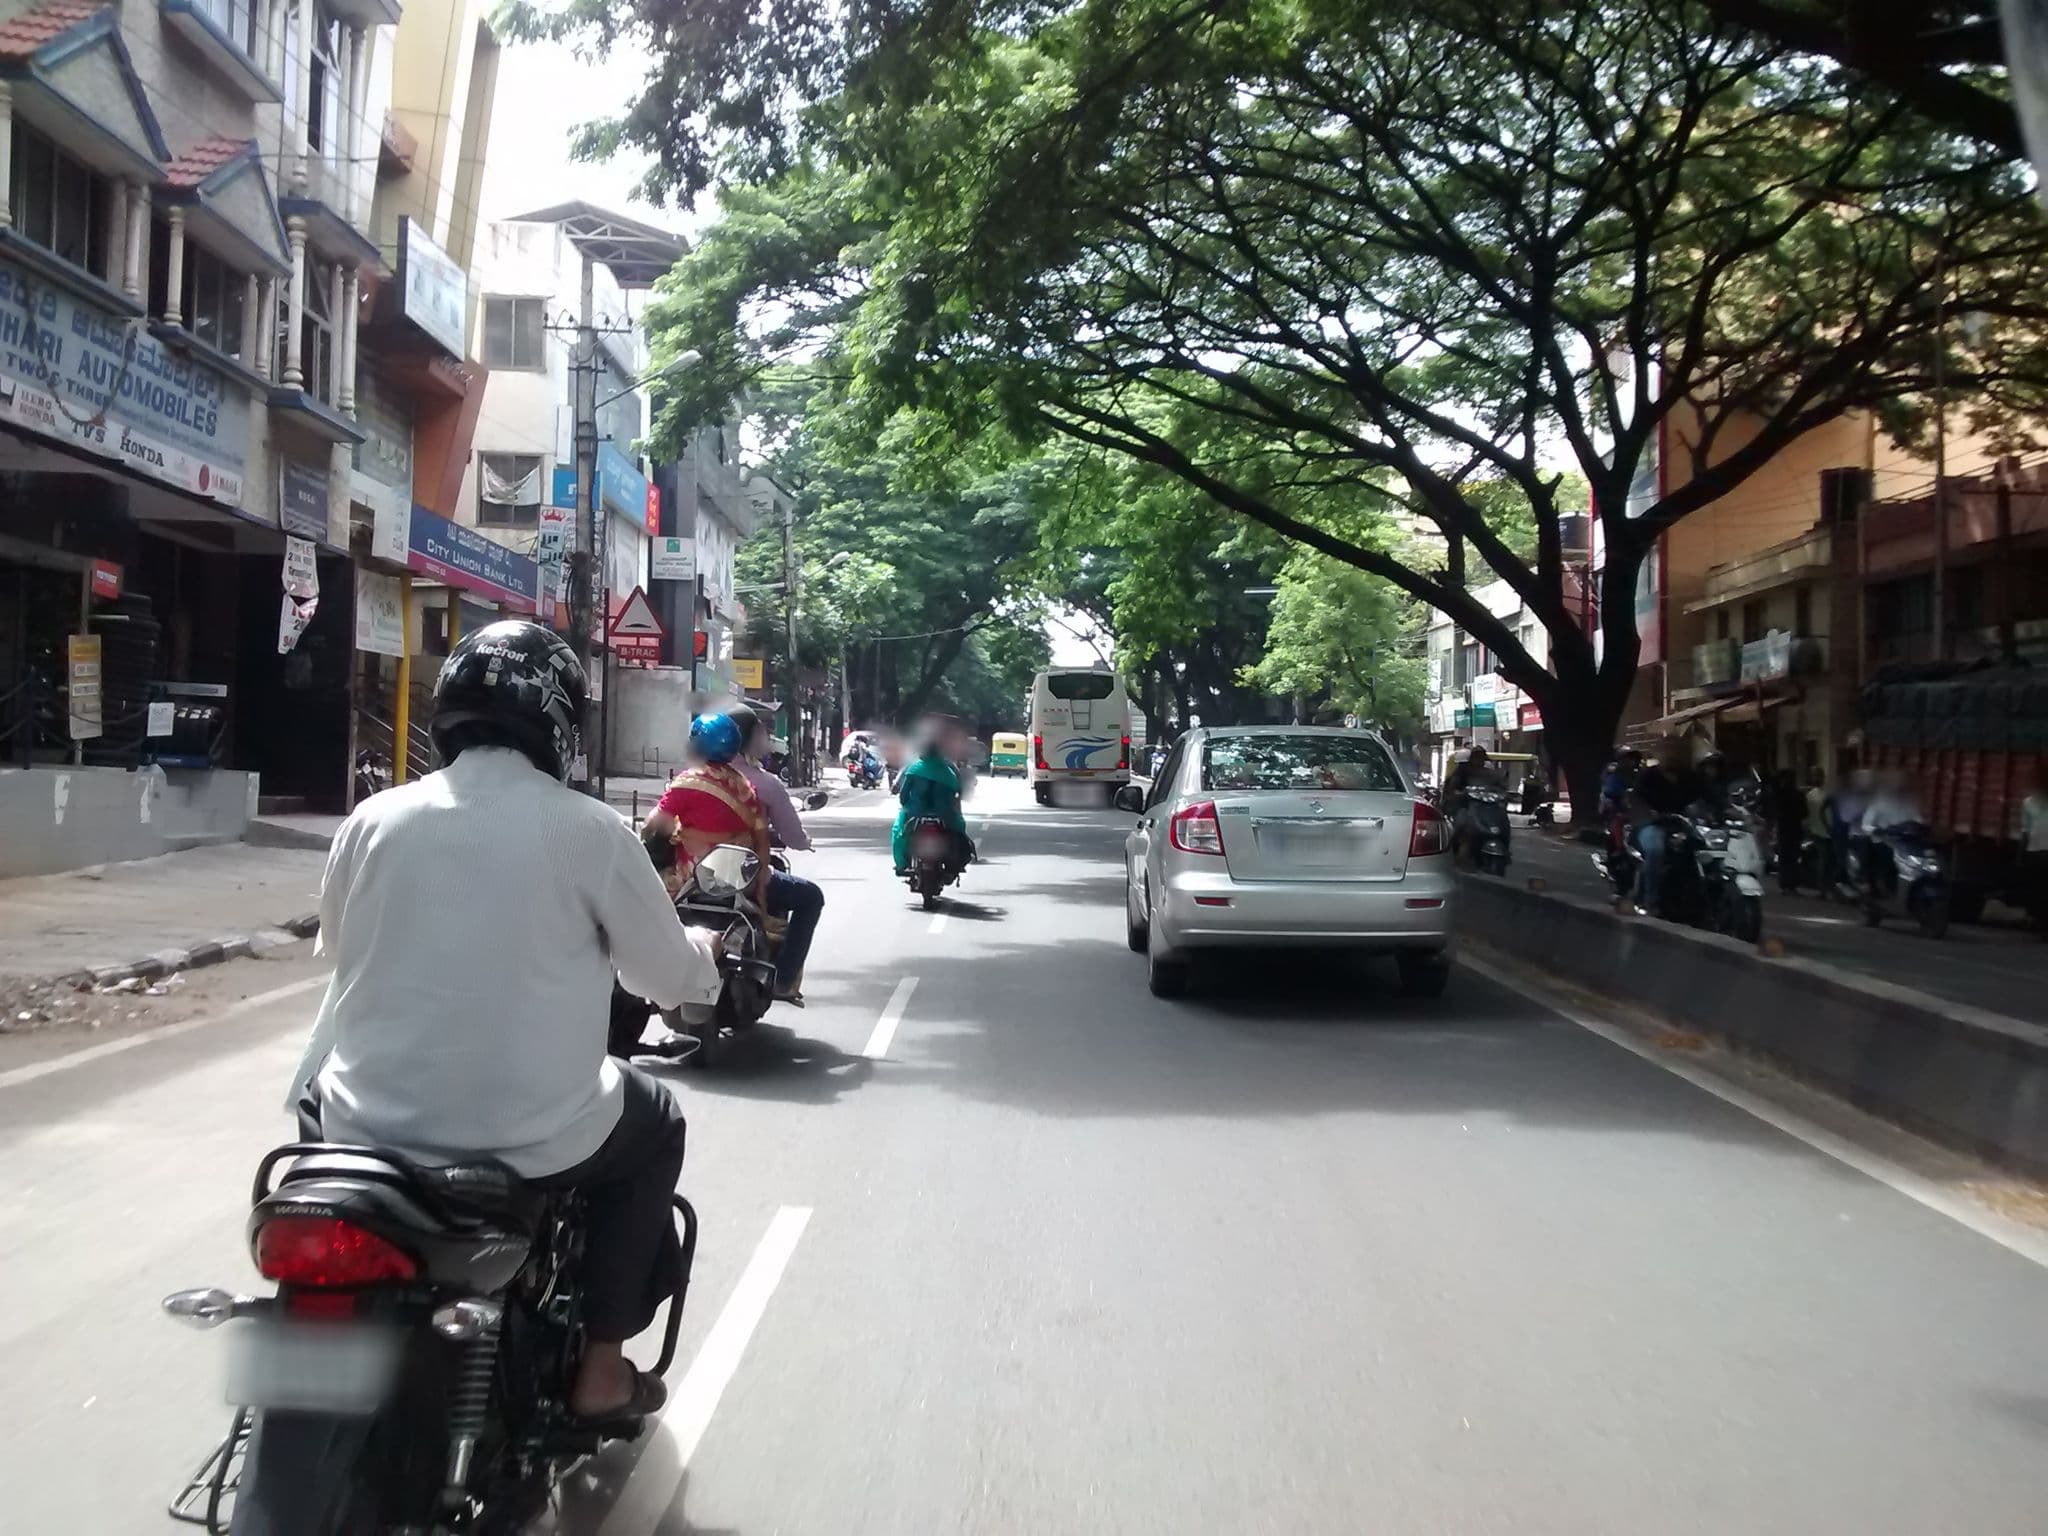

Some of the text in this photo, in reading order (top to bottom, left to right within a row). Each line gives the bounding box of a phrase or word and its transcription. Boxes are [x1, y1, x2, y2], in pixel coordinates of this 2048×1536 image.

[0, 308, 63, 366] HARI
[78, 349, 218, 438] AUTOMOBILES
[7, 351, 48, 380] TWO
[71, 420, 106, 444] TVS
[119, 436, 165, 467] HONDA
[426, 538, 450, 560] CITY
[452, 551, 481, 574] UNION
[484, 563, 507, 582] BANK
[620, 647, 656, 658] B-TRAC
